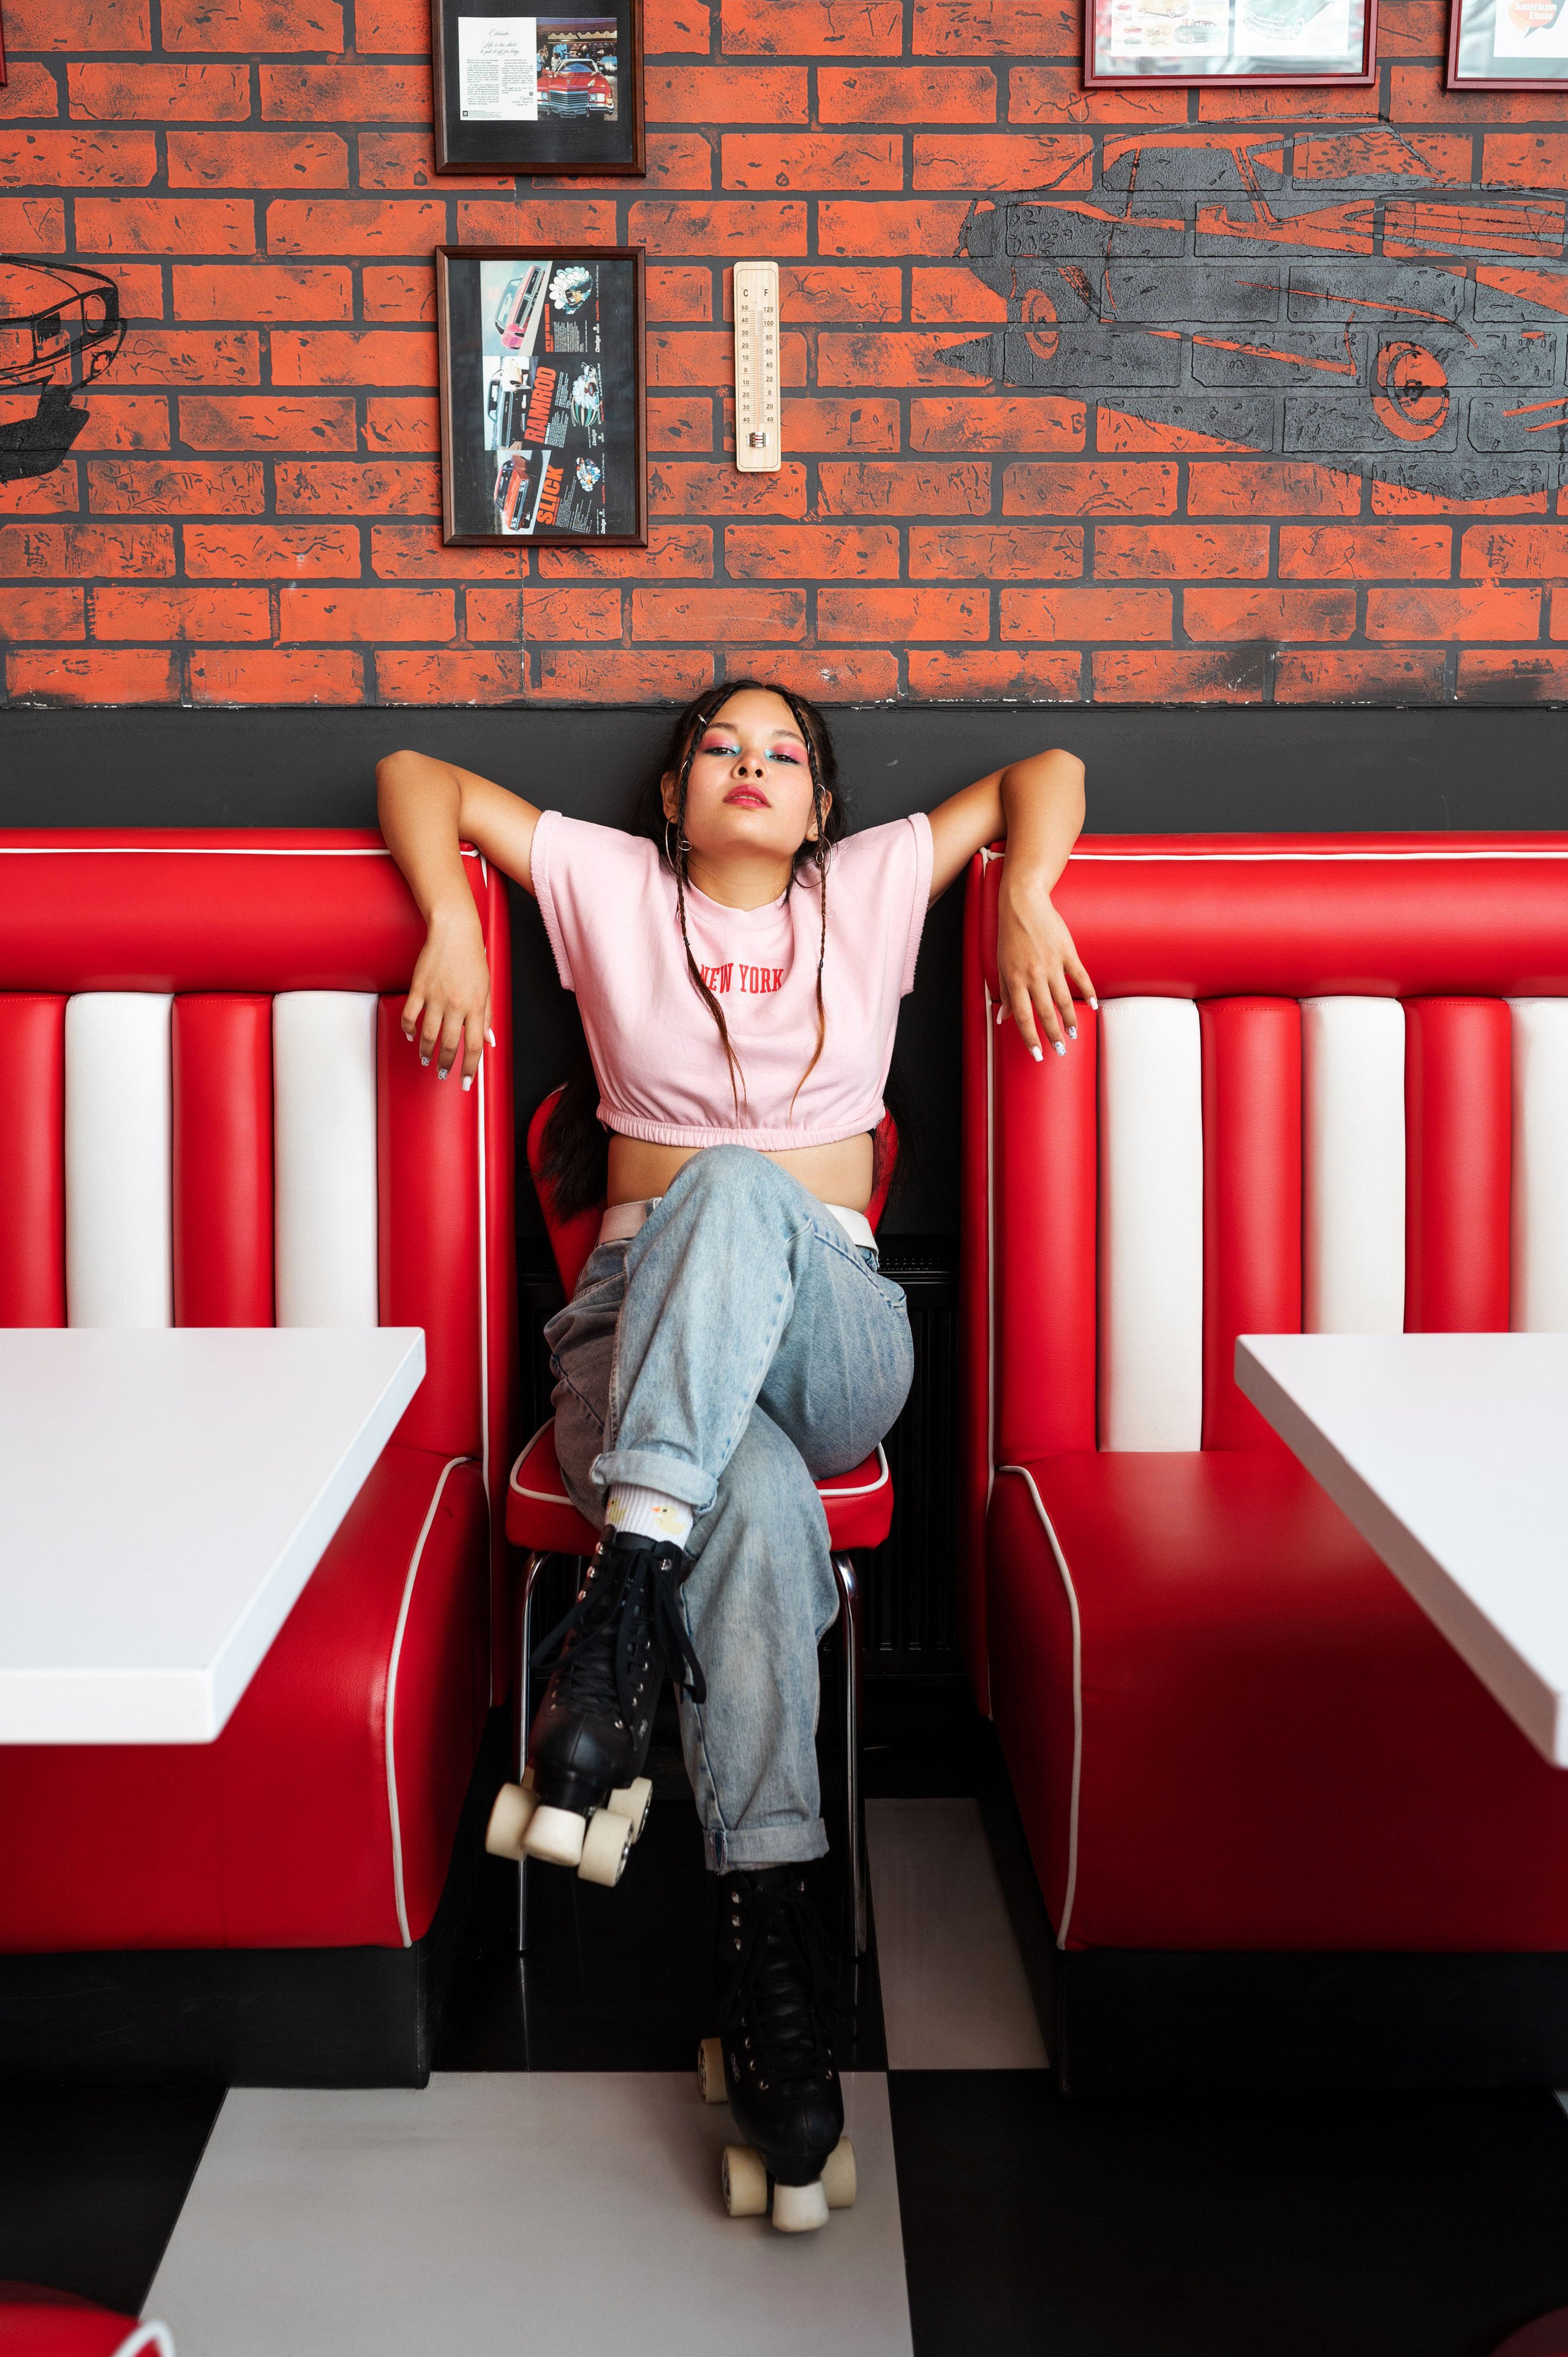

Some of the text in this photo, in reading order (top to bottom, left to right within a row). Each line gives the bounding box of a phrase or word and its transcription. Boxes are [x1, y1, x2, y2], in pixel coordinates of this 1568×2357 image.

[524, 366, 556, 443] RAMROD
[537, 465, 564, 524] SLICK
[696, 963, 783, 994] NEW YORK
